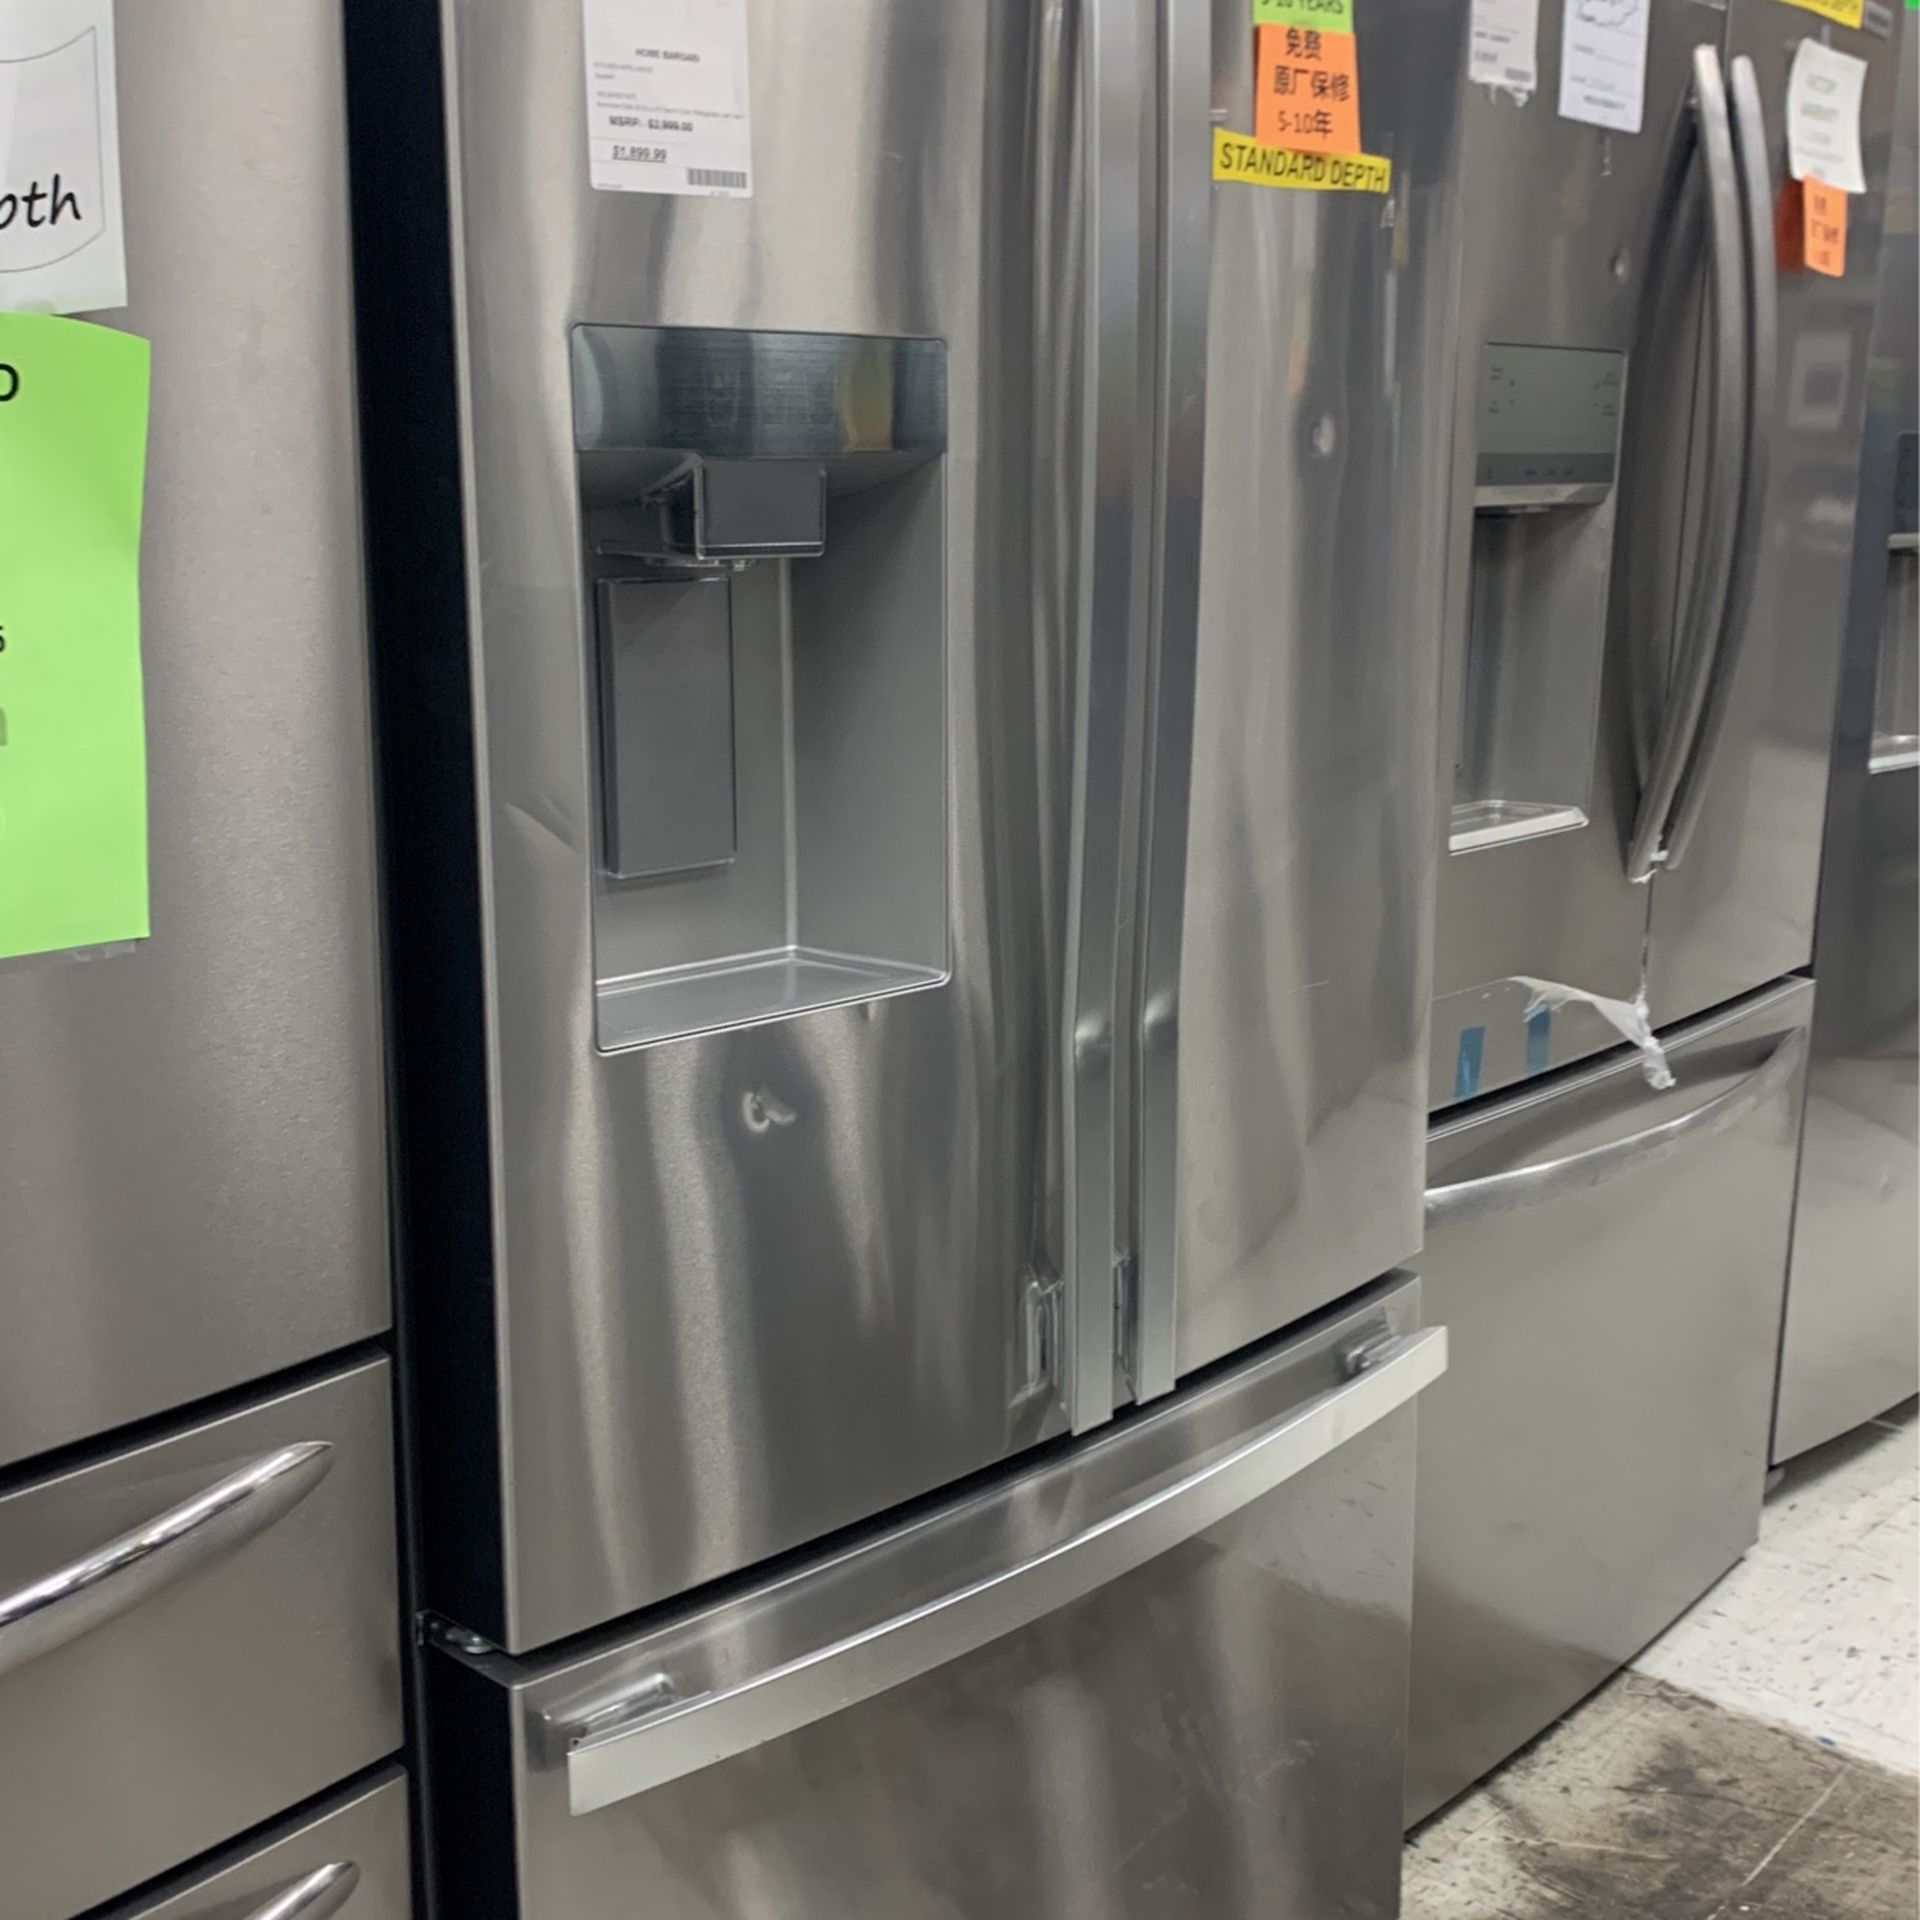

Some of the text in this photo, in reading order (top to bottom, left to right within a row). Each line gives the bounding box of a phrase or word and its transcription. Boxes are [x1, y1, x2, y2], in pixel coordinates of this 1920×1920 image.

[1285, 27, 1322, 60] 免费
[1273, 65, 1351, 101] 原厂保修
[1278, 108, 1333, 139] 5-10年
[1219, 142, 1387, 194] STANDARD DEPTH
